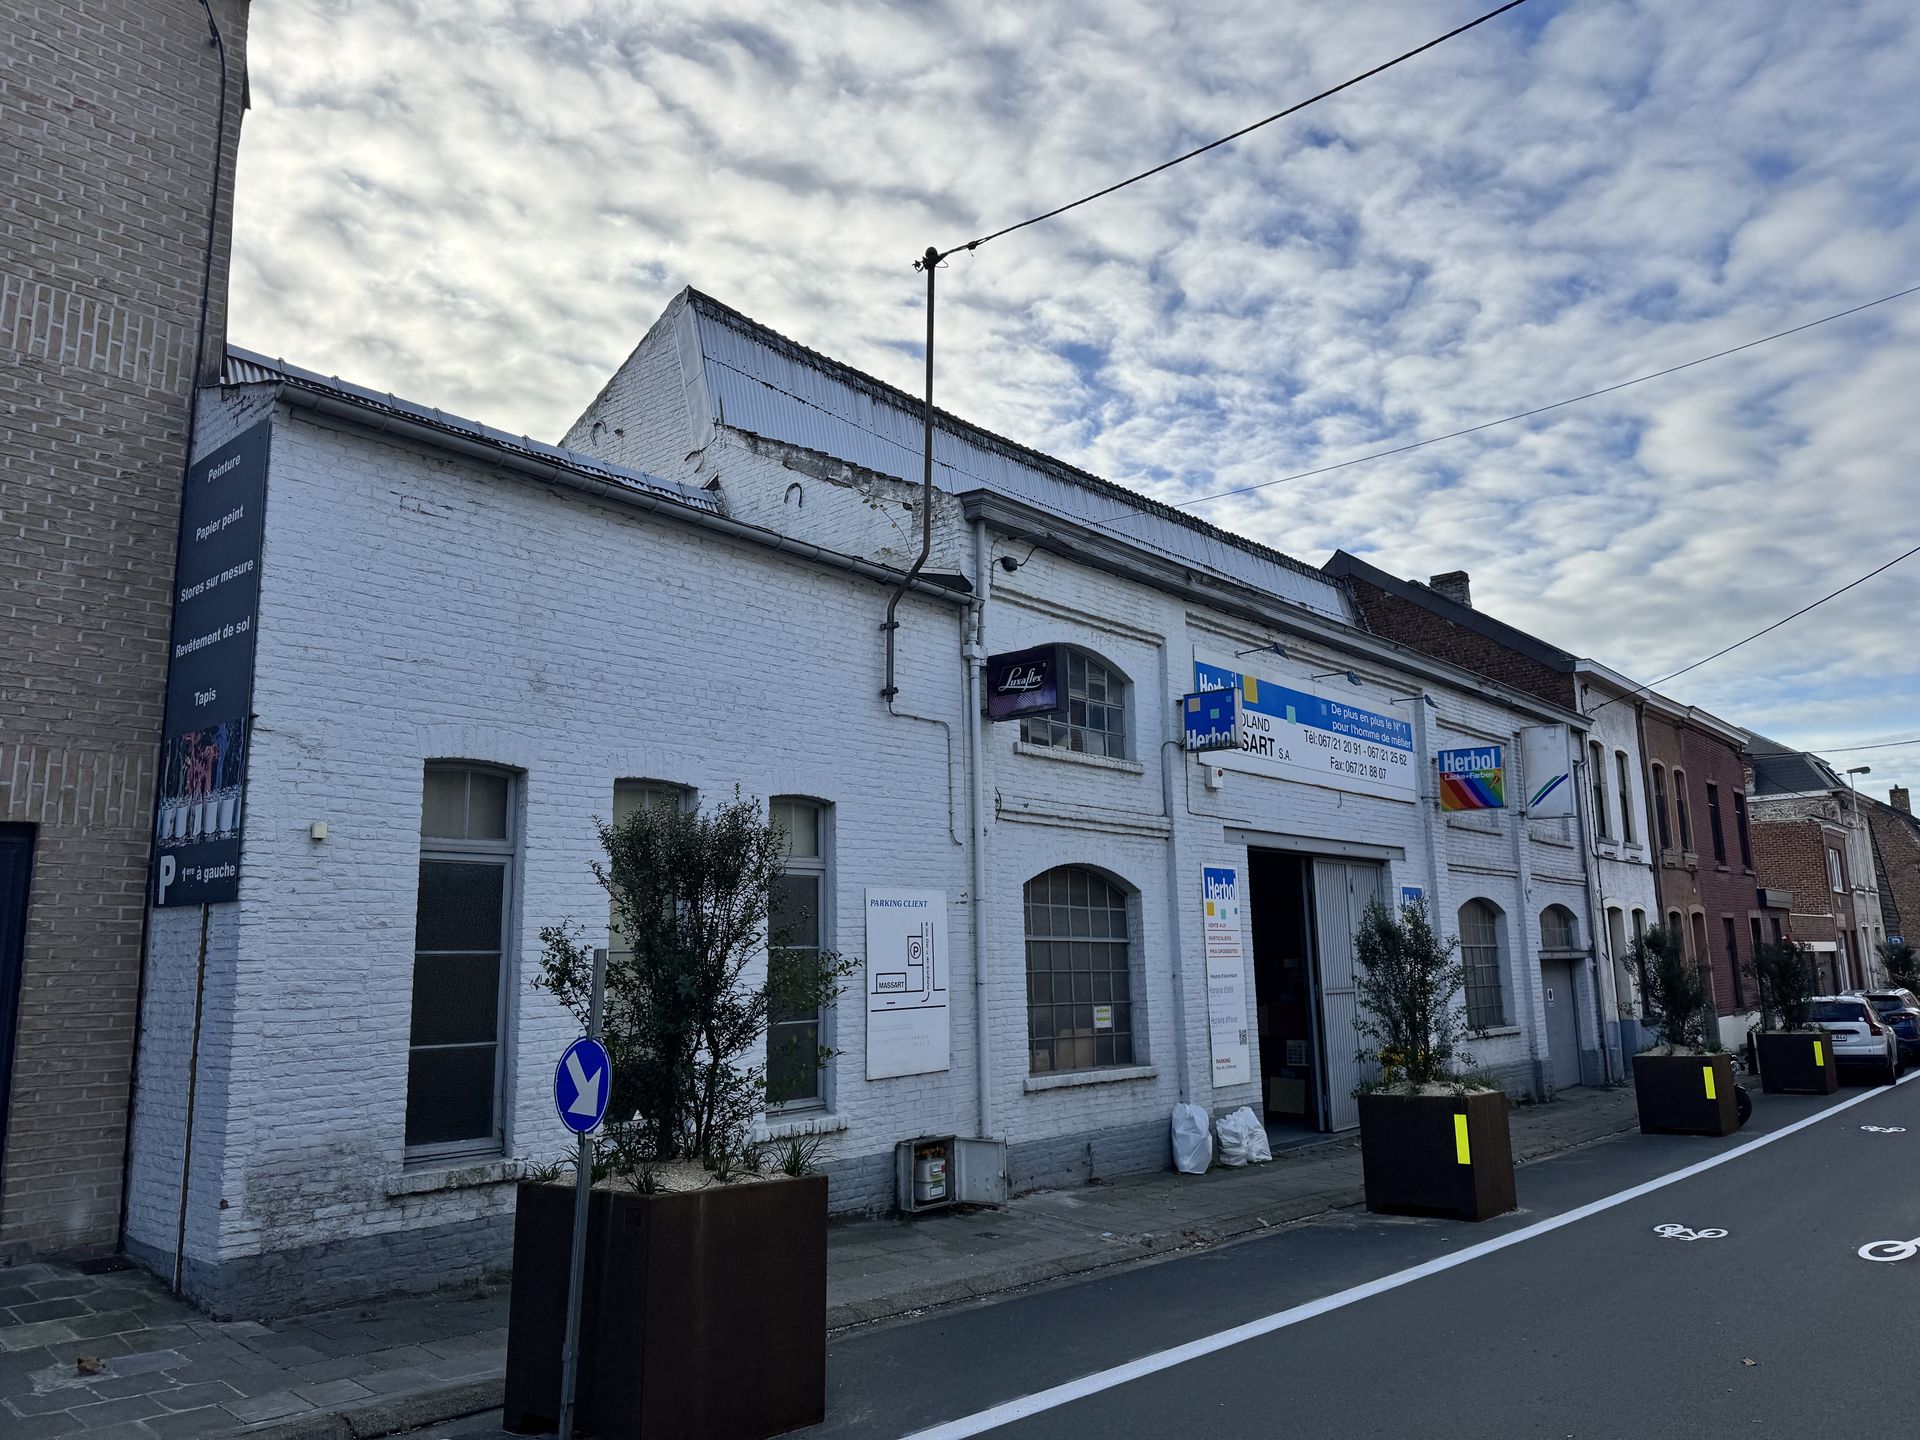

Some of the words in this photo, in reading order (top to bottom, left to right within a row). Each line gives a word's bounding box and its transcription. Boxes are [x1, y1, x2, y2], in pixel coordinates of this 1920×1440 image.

[208, 454, 241, 483] Peinture
[196, 516, 221, 542] Papier
[222, 504, 244, 530] peint
[181, 582, 204, 602] Stores
[206, 574, 220, 590] sur
[220, 559, 254, 583] mesure
[222, 623, 234, 638] de
[236, 616, 250, 634] sol
[998, 667, 1043, 692] Luxaflex
[194, 687, 216, 707] Tapis
[1331, 703, 1341, 716] De
[1343, 708, 1358, 721] plus
[1360, 714, 1369, 724] en
[1370, 716, 1385, 728] plus
[1385, 718, 1392, 730] le
[1402, 724, 1407, 734] 1
[1185, 724, 1235, 750] Herbol
[1332, 721, 1349, 733] pour
[1350, 723, 1380, 740] l'homme
[1381, 731, 1390, 742] de
[1391, 736, 1411, 749] métier
[1343, 740, 1352, 754] 20
[1353, 742, 1361, 755] 91
[1390, 751, 1398, 764] 25
[1443, 748, 1496, 772] Herbol
[1378, 768, 1386, 780] 07
[158, 855, 176, 905] P
[196, 865, 202, 880] à
[203, 862, 235, 883] gauche
[1207, 876, 1237, 900] Herbol
[870, 899, 902, 908] PARKING
[903, 900, 928, 908] CLIENT
[878, 981, 905, 989] MASSART
